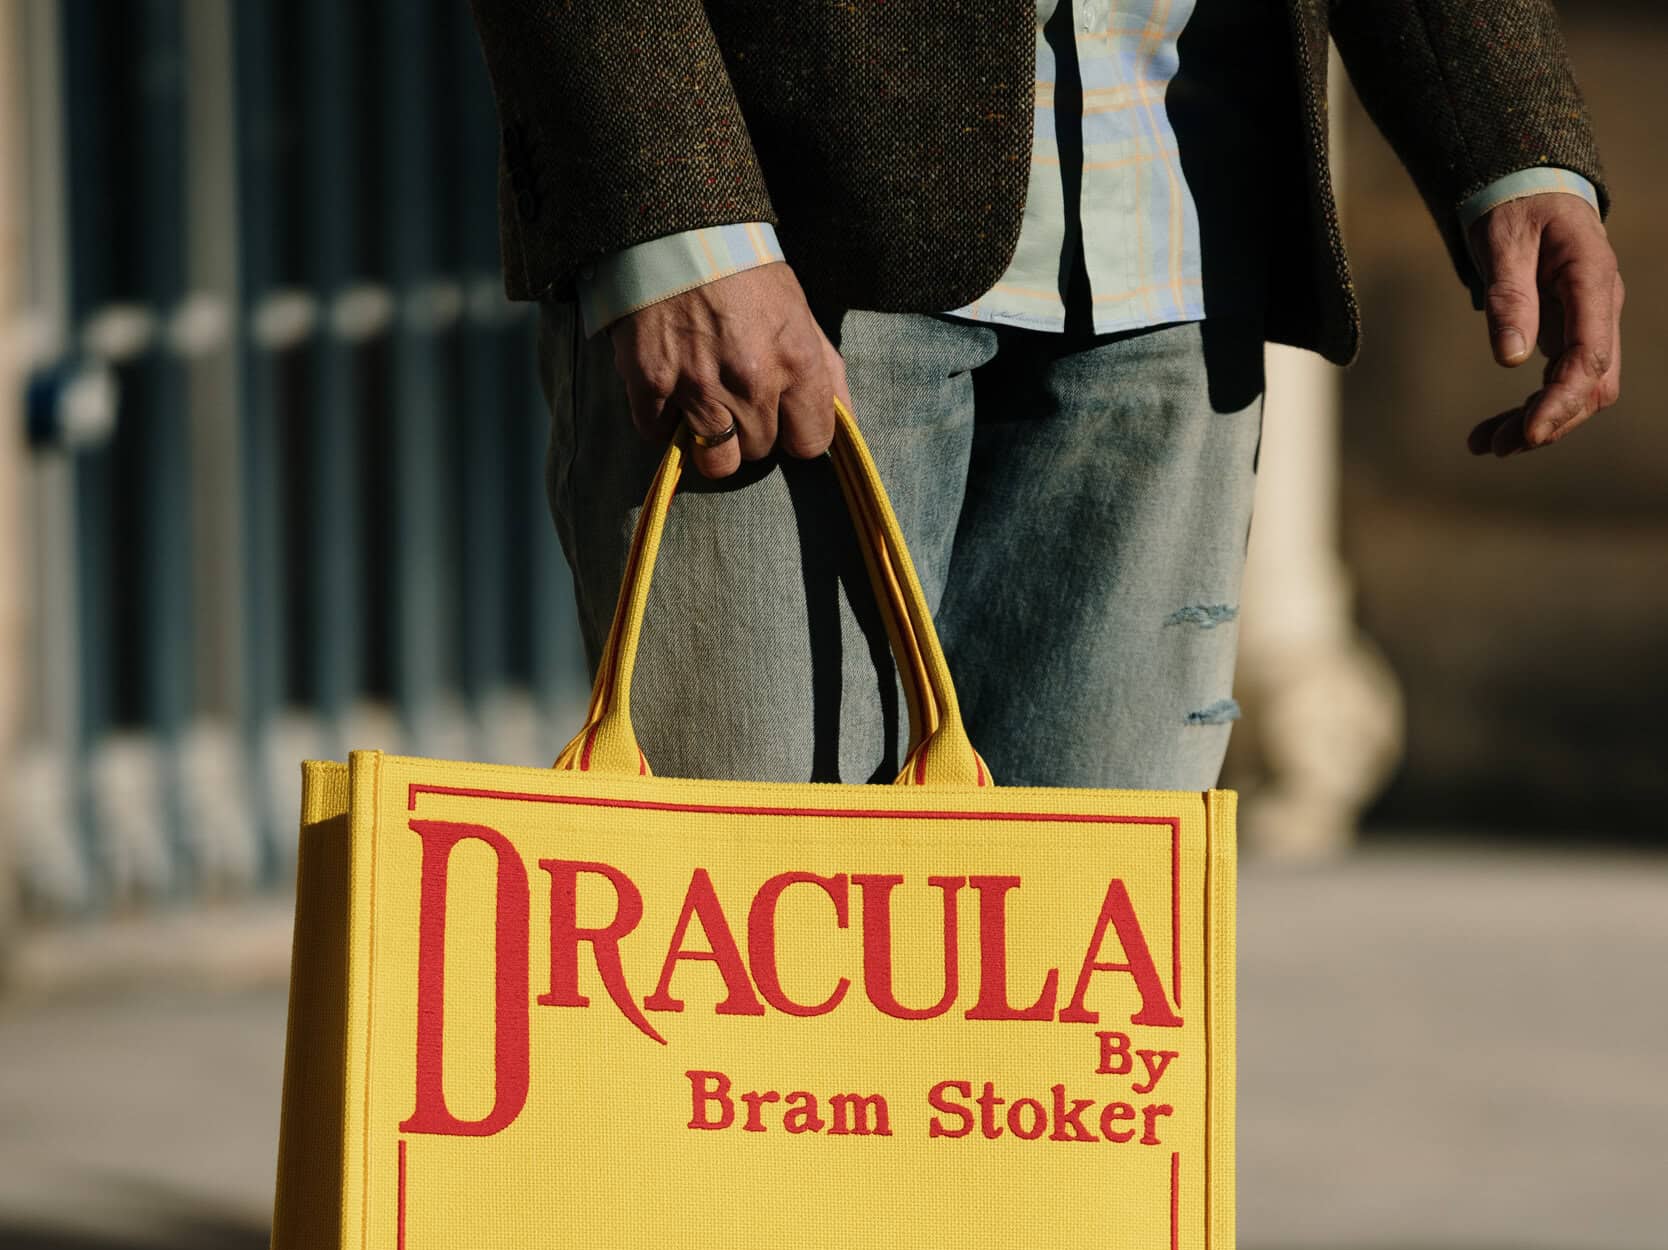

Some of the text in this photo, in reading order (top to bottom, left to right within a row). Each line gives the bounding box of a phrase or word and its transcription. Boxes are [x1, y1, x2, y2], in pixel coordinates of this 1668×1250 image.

[397, 818, 1184, 1138] DRACULA
[1094, 1031, 1180, 1095] By
[685, 1070, 1174, 1147] Bram Stoker
